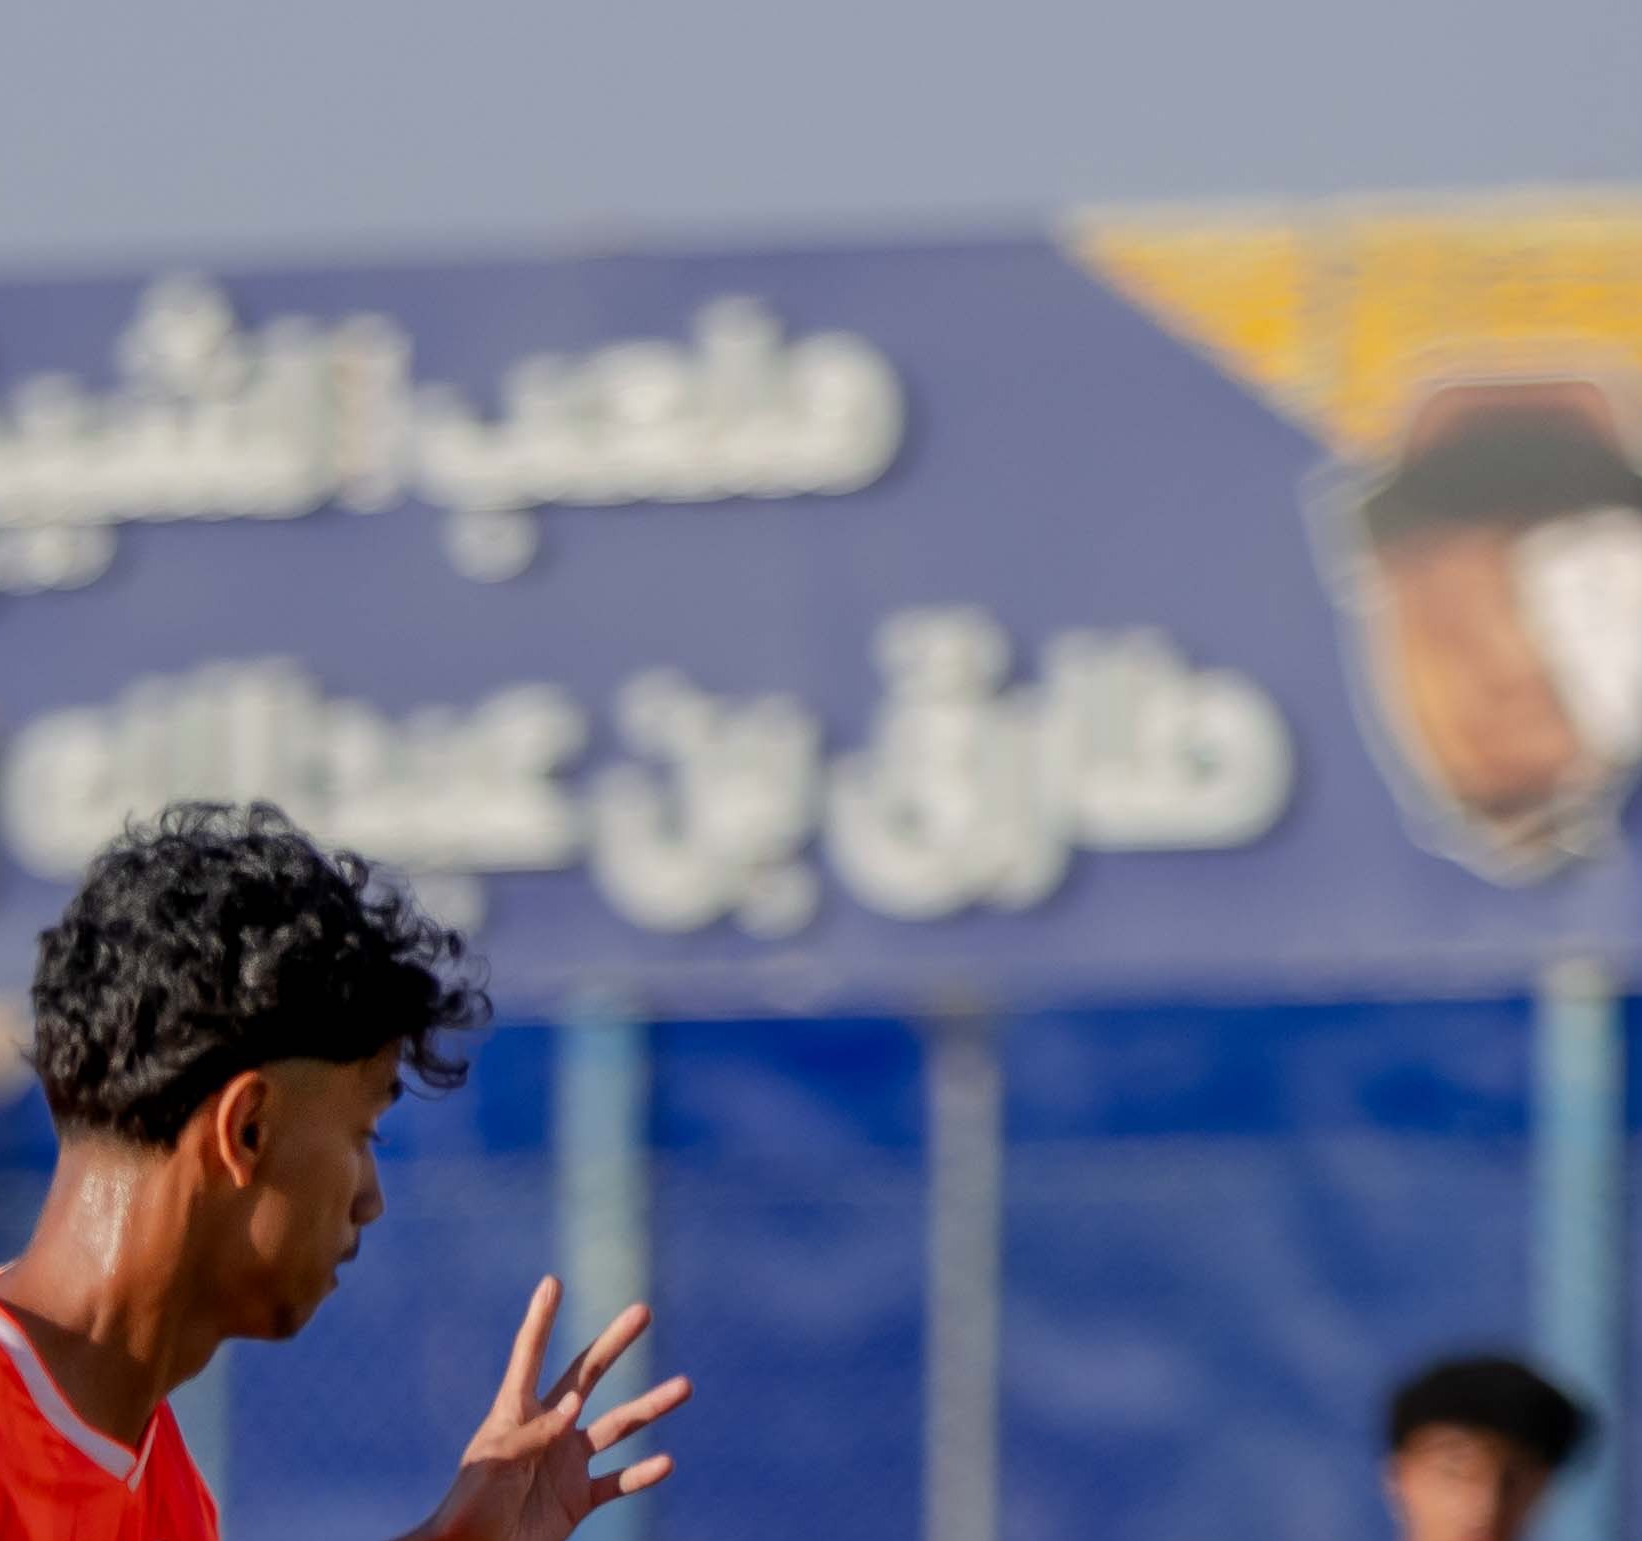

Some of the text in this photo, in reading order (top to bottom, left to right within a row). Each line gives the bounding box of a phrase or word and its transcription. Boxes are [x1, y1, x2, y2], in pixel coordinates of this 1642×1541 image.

[421, 302, 897, 576] ملعب
[593, 667, 822, 937] بن
[829, 612, 1287, 915] طارق
